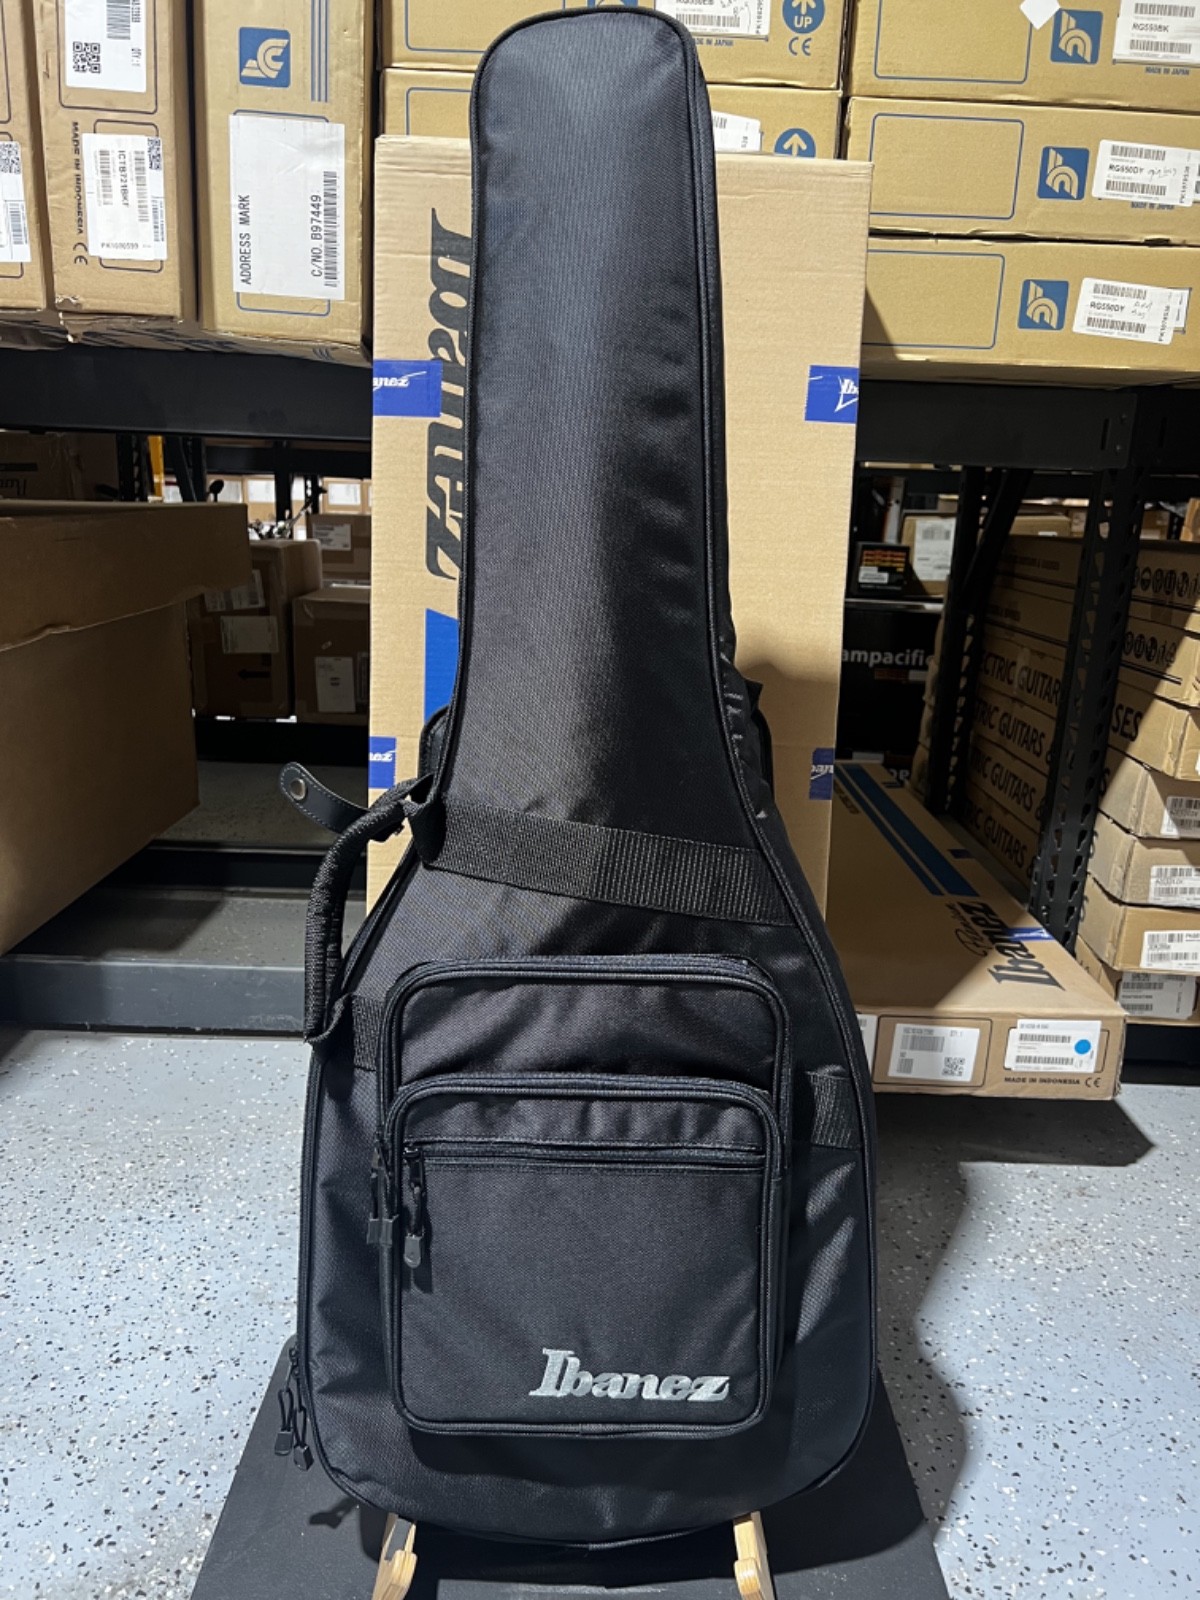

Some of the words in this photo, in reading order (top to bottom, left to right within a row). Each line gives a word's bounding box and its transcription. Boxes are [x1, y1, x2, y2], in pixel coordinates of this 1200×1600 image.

[794, 16, 813, 28] UP
[238, 194, 251, 226] MARK
[310, 194, 322, 241] B97449
[239, 232, 252, 285] ADDRESS
[999, 711, 1046, 758] GUITARS
[991, 762, 1036, 812] GUITARS
[984, 815, 1028, 868] GUITARS
[529, 1347, 731, 1402] Ibanez
